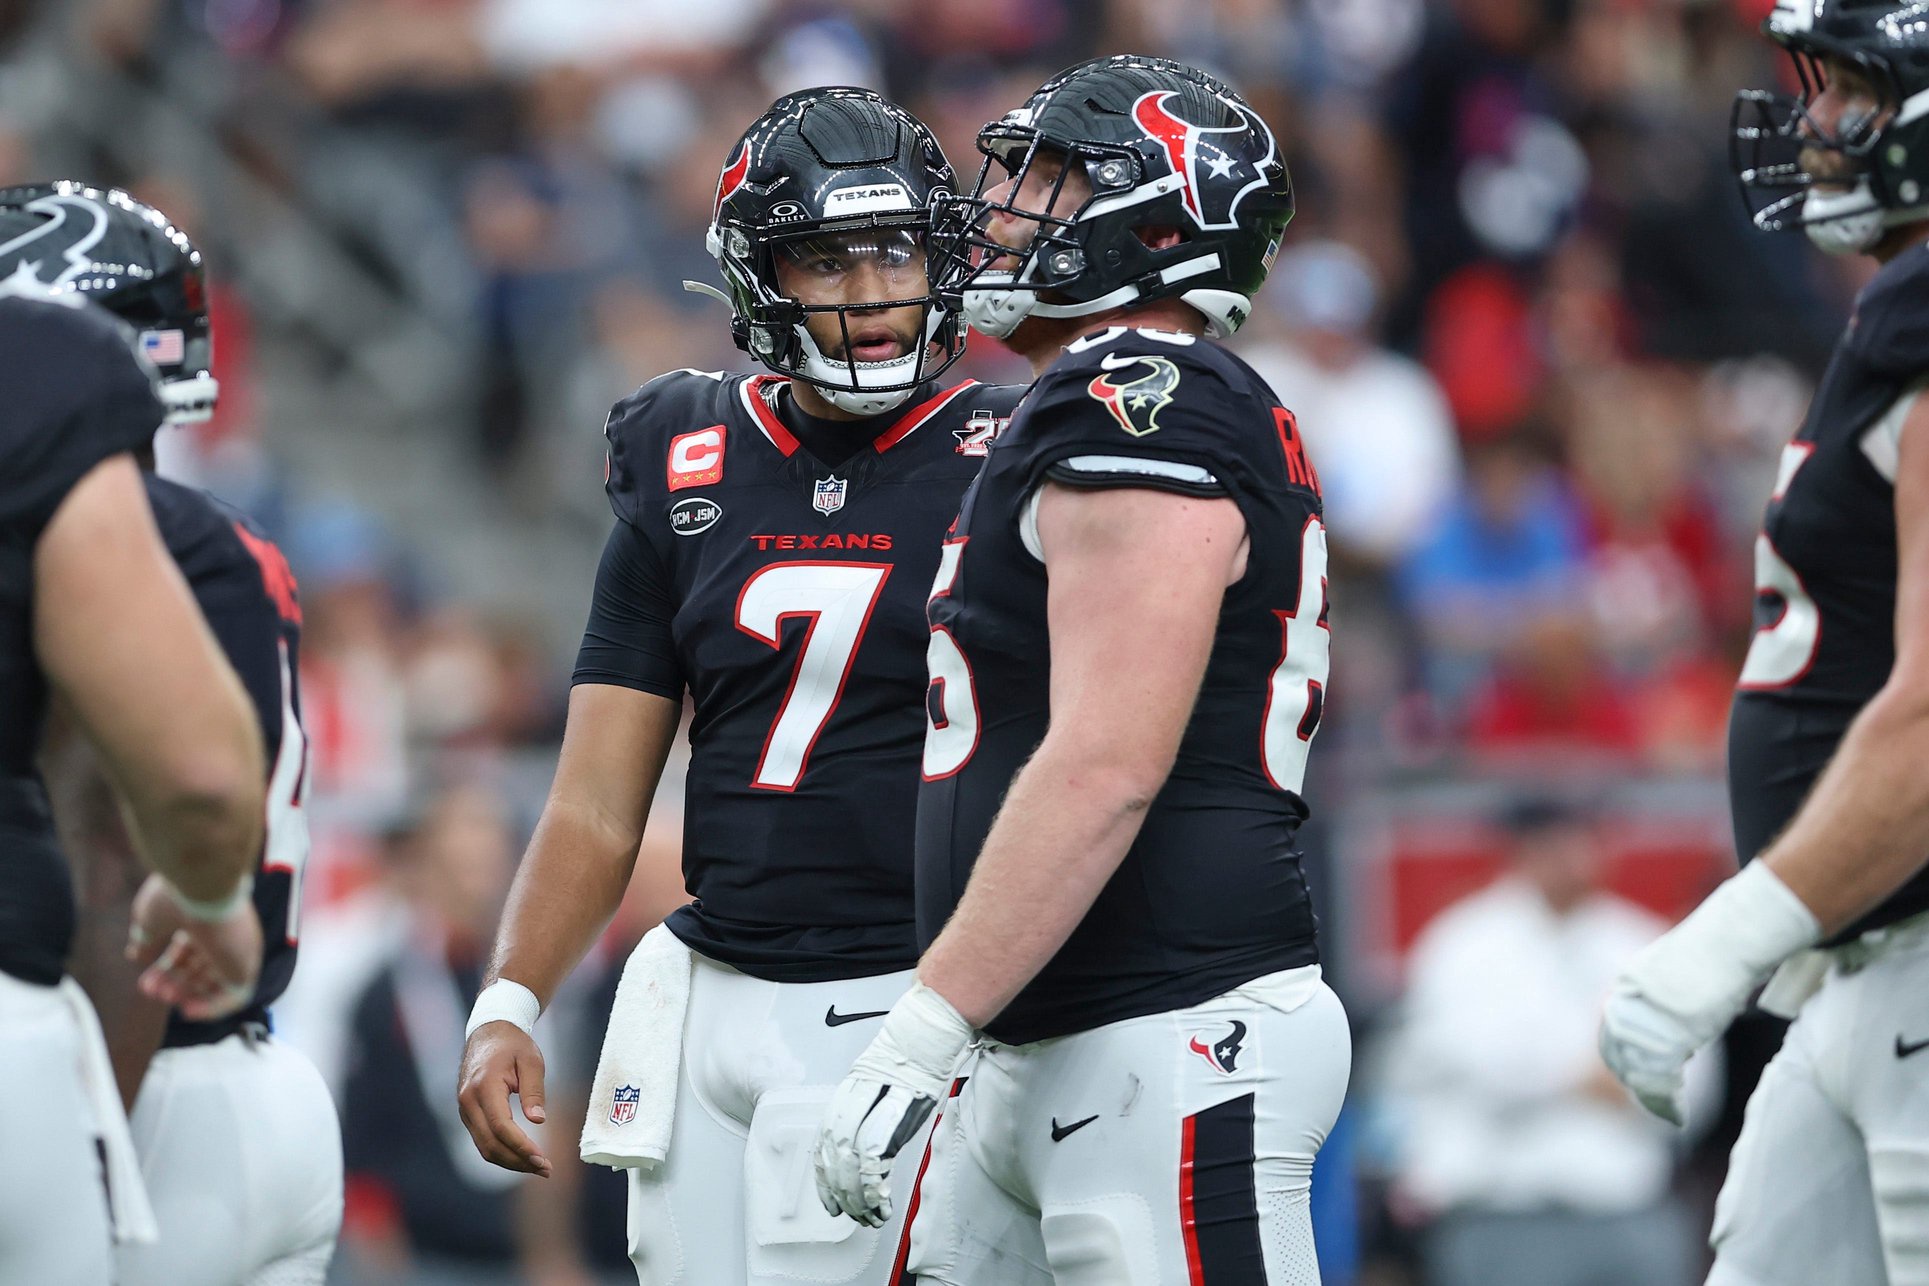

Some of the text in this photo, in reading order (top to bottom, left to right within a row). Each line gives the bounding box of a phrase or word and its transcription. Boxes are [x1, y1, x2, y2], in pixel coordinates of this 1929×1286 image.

[833, 188, 901, 202] TEXANS
[768, 214, 806, 224] OAKLEY
[671, 430, 721, 474] C
[818, 493, 840, 508] NFL
[694, 507, 716, 521] JSM
[750, 533, 893, 551] TEXANS
[734, 559, 894, 793] 7
[611, 1102, 634, 1122] NFL
